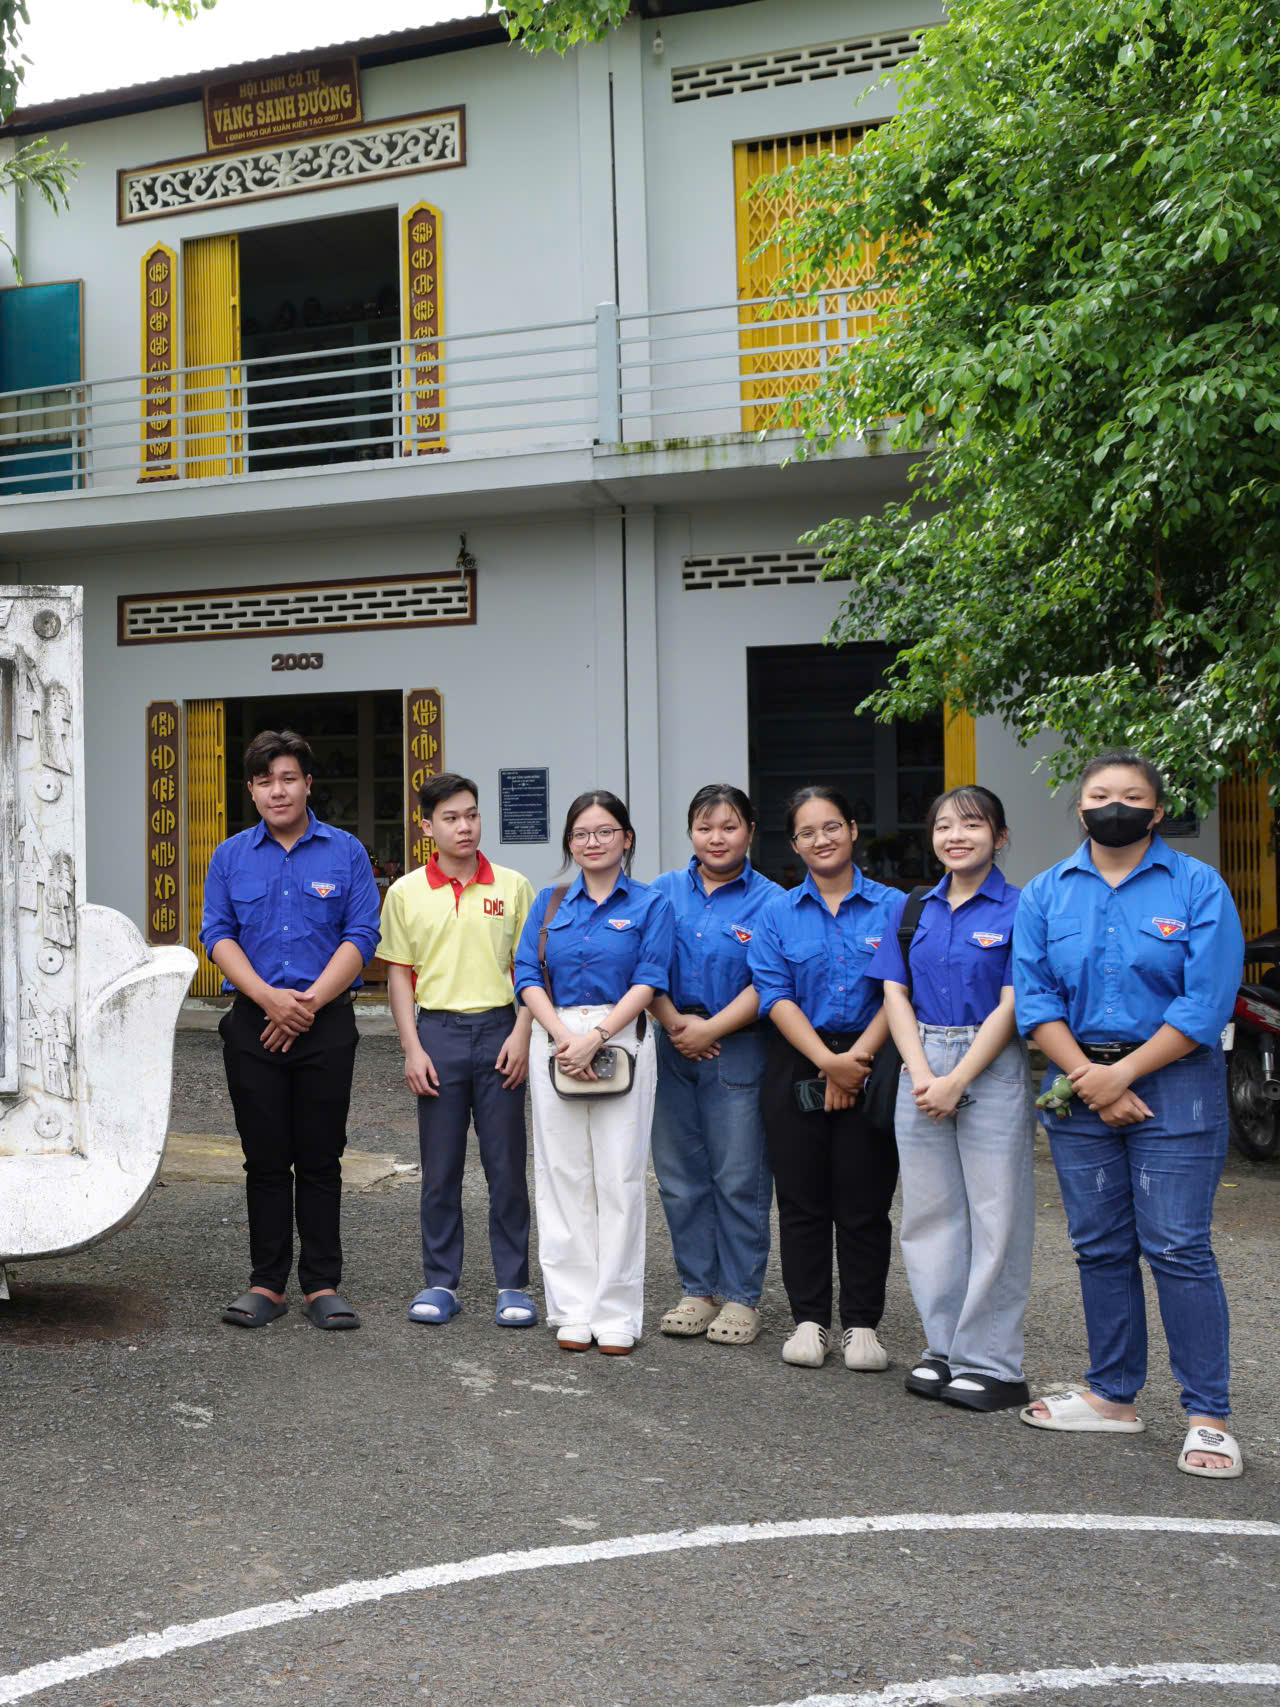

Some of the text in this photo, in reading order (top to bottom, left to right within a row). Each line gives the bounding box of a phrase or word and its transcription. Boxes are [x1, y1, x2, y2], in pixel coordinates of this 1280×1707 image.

[240, 84, 258, 99] HỘI
[260, 75, 285, 95] LINH
[256, 95, 297, 126] SANH
[297, 81, 353, 117] ĐƯỜNG
[412, 223, 433, 243] SANH
[272, 652, 323, 671] 2003
[152, 841, 176, 868] NAY
[154, 873, 176, 900] XA
